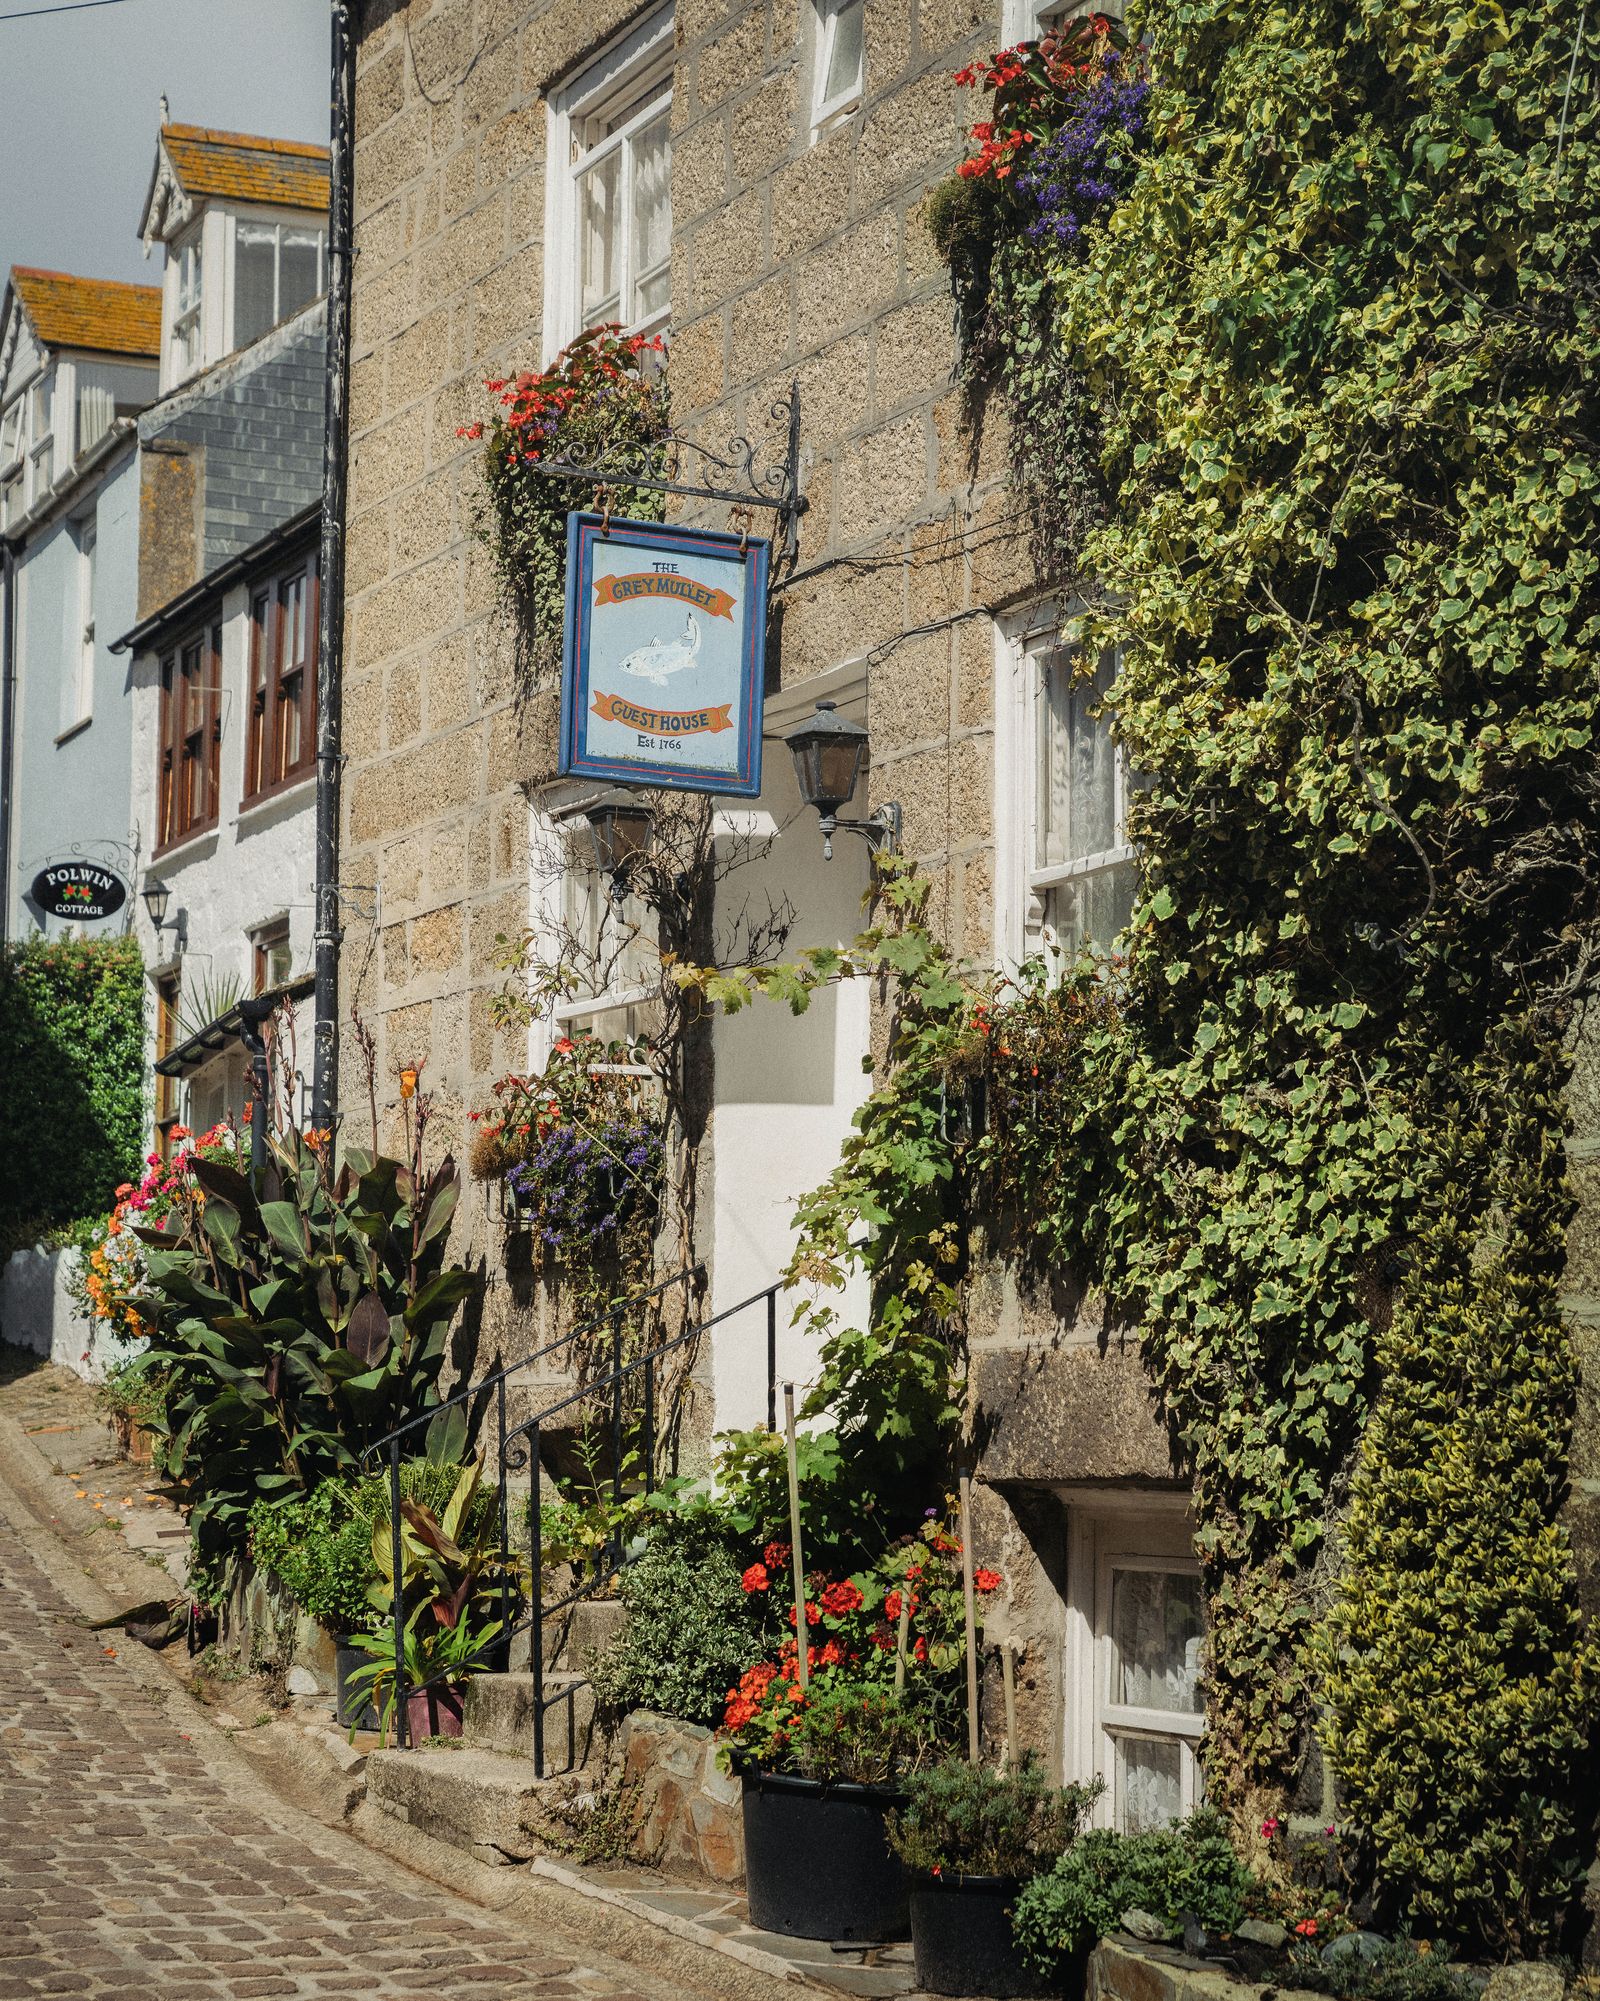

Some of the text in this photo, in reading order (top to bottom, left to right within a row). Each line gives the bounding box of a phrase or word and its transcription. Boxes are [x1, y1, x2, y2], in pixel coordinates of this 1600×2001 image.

[652, 561, 679, 573] THE
[612, 578, 716, 605] GREY MULLET
[611, 700, 709, 731] GUEST HOUSE
[637, 734, 681, 749] Est 1766
[46, 868, 114, 890] POLWIN
[55, 903, 104, 915] COTTAGE
